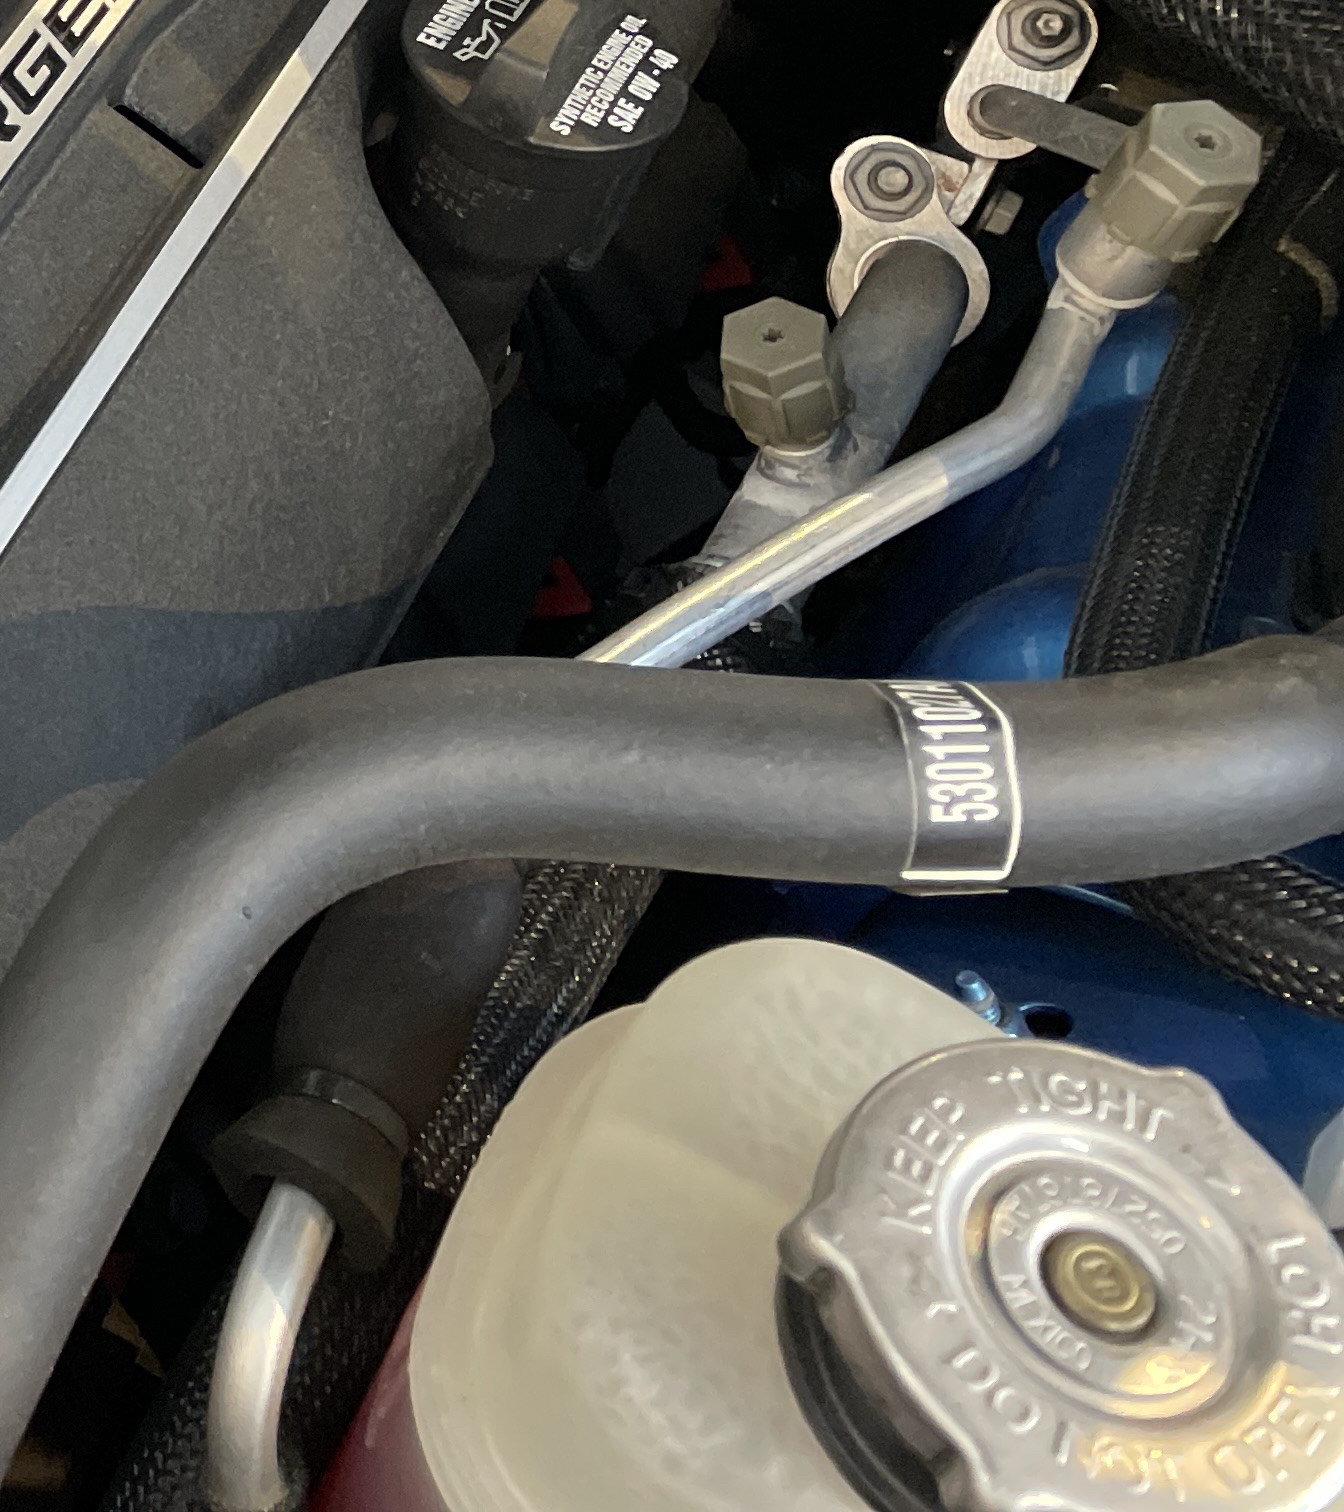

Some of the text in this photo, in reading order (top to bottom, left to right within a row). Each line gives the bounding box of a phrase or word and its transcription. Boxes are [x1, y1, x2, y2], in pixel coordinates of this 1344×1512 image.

[549, 14, 648, 136] SYNTHETIC ENGINE OIL
[579, 34, 654, 128] RECOMMENDED
[607, 97, 645, 133] SAE
[881, 1095, 966, 1235] KEEP
[987, 1066, 1175, 1141] TIGHT
